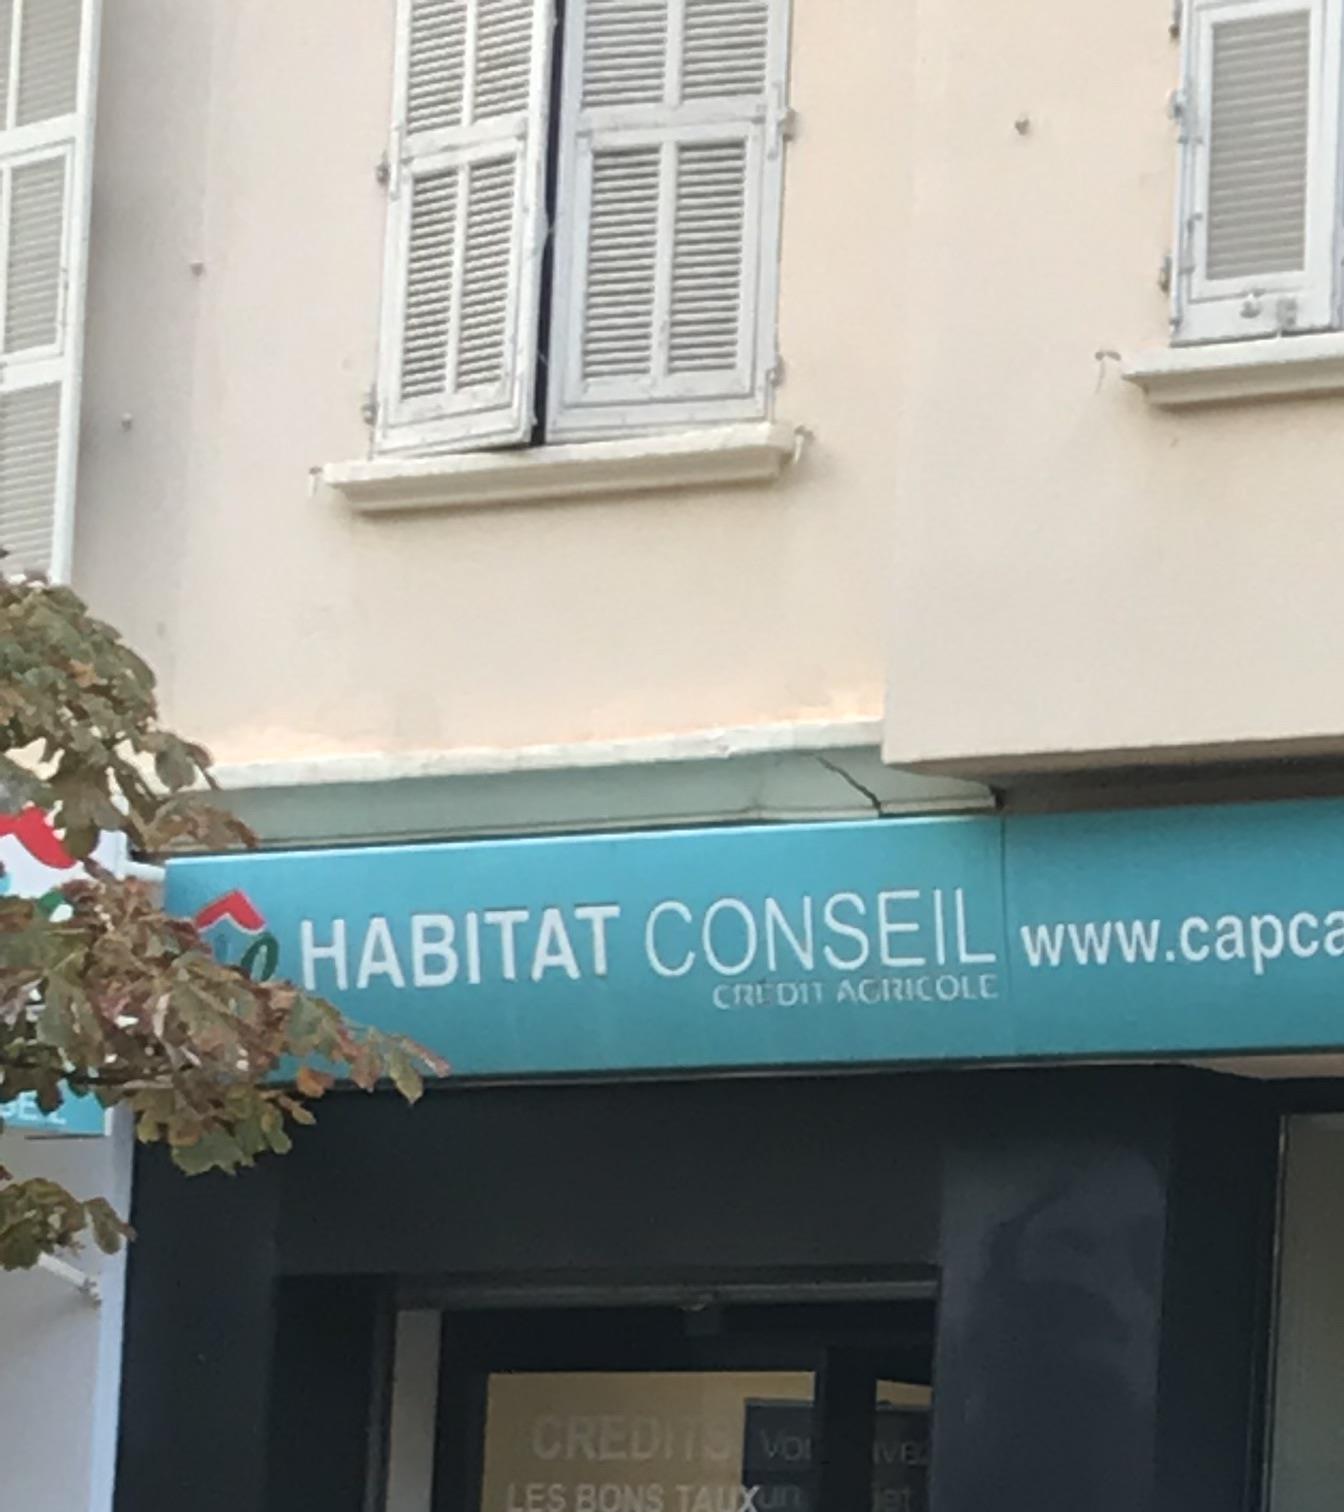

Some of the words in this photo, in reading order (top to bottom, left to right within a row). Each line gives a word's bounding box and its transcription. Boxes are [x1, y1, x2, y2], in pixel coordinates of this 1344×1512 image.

[301, 905, 621, 991] HABITAT
[645, 888, 997, 977] CONSEIL
[836, 973, 999, 1005] AGRICOLE
